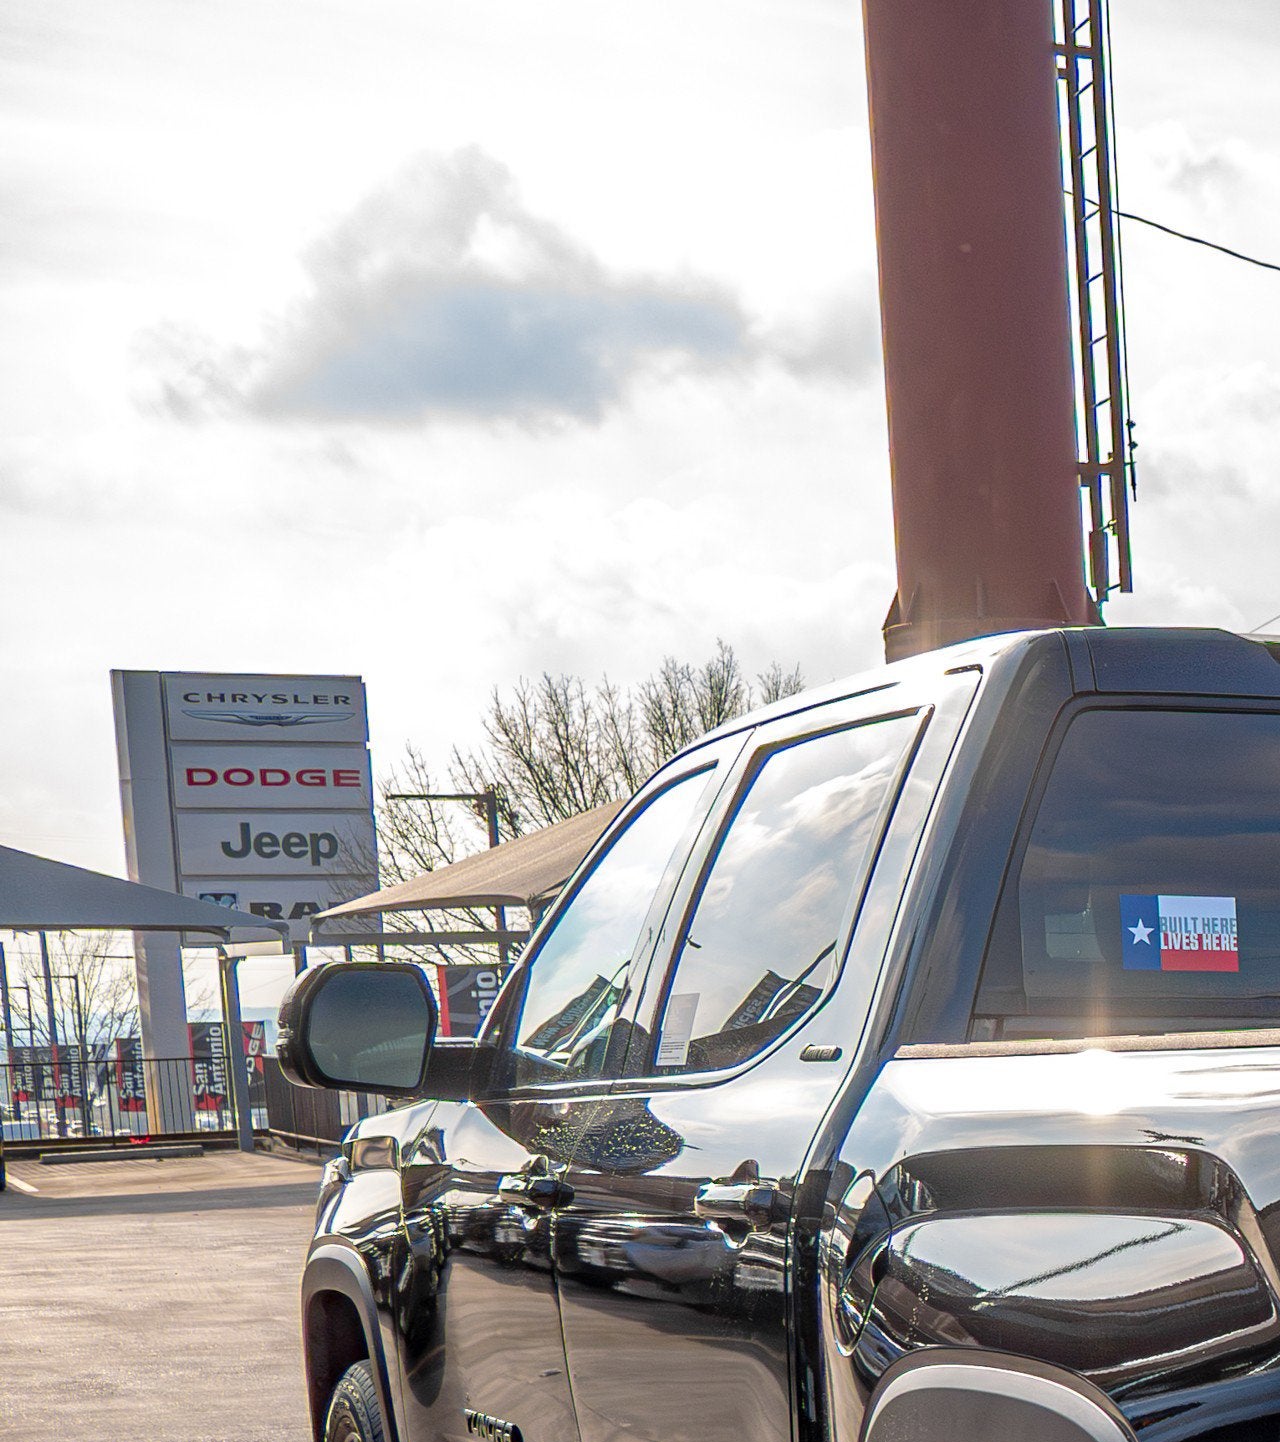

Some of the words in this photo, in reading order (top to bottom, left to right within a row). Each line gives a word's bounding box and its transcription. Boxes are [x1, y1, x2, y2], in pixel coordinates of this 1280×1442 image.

[183, 692, 351, 706] CHRYSLER
[186, 768, 362, 787] DODGE
[221, 822, 339, 866] Jeep
[250, 902, 346, 920] RA
[1159, 916, 1199, 935] BUILT
[1201, 917, 1237, 935] HERE
[1160, 933, 1199, 951] LIVES
[1201, 935, 1238, 952] HERE
[205, 1026, 226, 1096] Antonio
[193, 1063, 208, 1096] San
